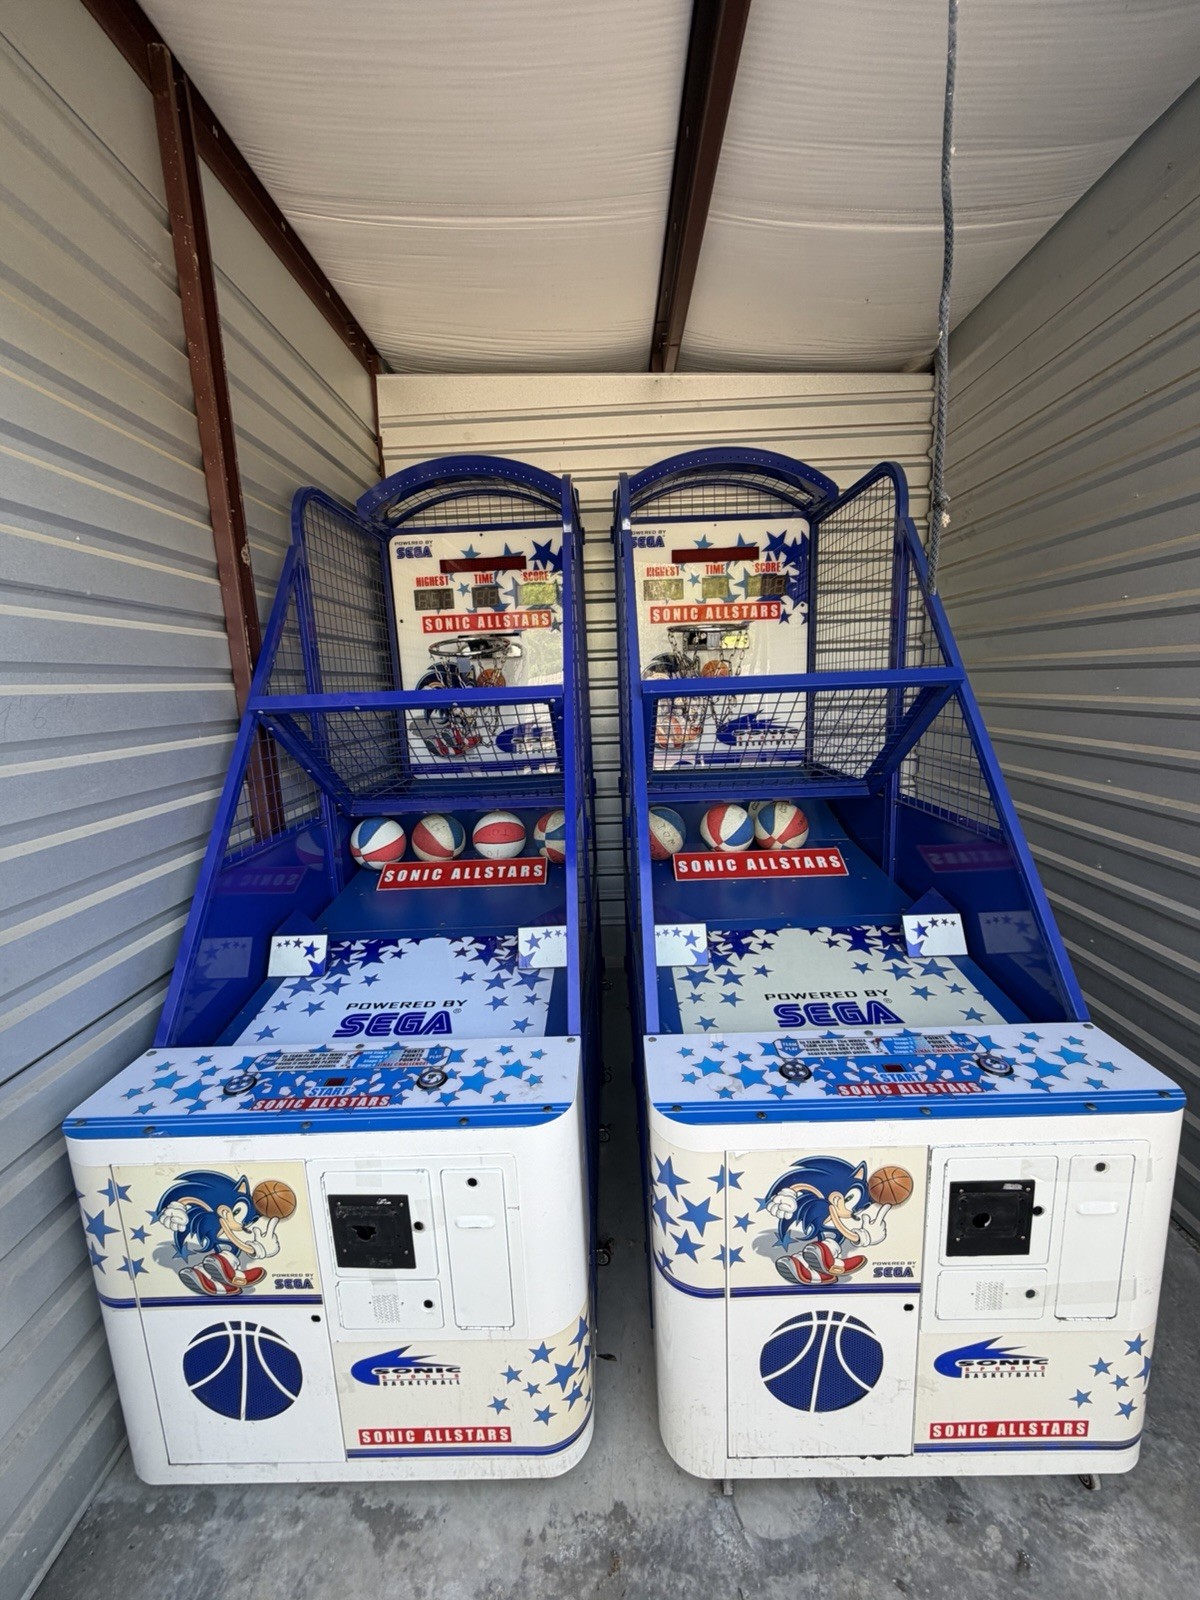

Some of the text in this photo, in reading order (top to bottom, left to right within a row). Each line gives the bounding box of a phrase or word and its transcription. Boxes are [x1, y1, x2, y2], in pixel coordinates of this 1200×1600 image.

[396, 546, 432, 559] SEGA
[646, 566, 680, 577] HIGHEST
[706, 564, 724, 574] TIME
[754, 562, 781, 573] SCORE
[416, 576, 449, 587] HIGHEST
[474, 574, 494, 584] TIME
[523, 571, 549, 582] SCORE
[653, 604, 778, 621] SONIC ALLSTARS
[425, 613, 549, 631] SONIC ALLSTARS
[678, 855, 841, 872] SONIC ALLSTARS
[384, 864, 543, 882] SONIC ALLSTARS
[764, 989, 889, 1000] POWERED BY
[346, 1000, 468, 1010] POWERED BY
[773, 1000, 906, 1028] SEGA
[332, 1011, 452, 1037] SEGA
[880, 1072, 922, 1082] START
[308, 1087, 351, 1096] START
[838, 1082, 983, 1096] SONIC ALLSTARS
[252, 1096, 390, 1110] SONIC ALLSTARS
[873, 1266, 914, 1278] SEGA
[274, 1278, 314, 1289] SEGA
[958, 1359, 1049, 1367] SONIC
[965, 1371, 1046, 1379] BASKETBALL
[932, 1422, 1086, 1437] SONIC ALLSTARS
[362, 1429, 509, 1443] SONIC ALLSTARS
